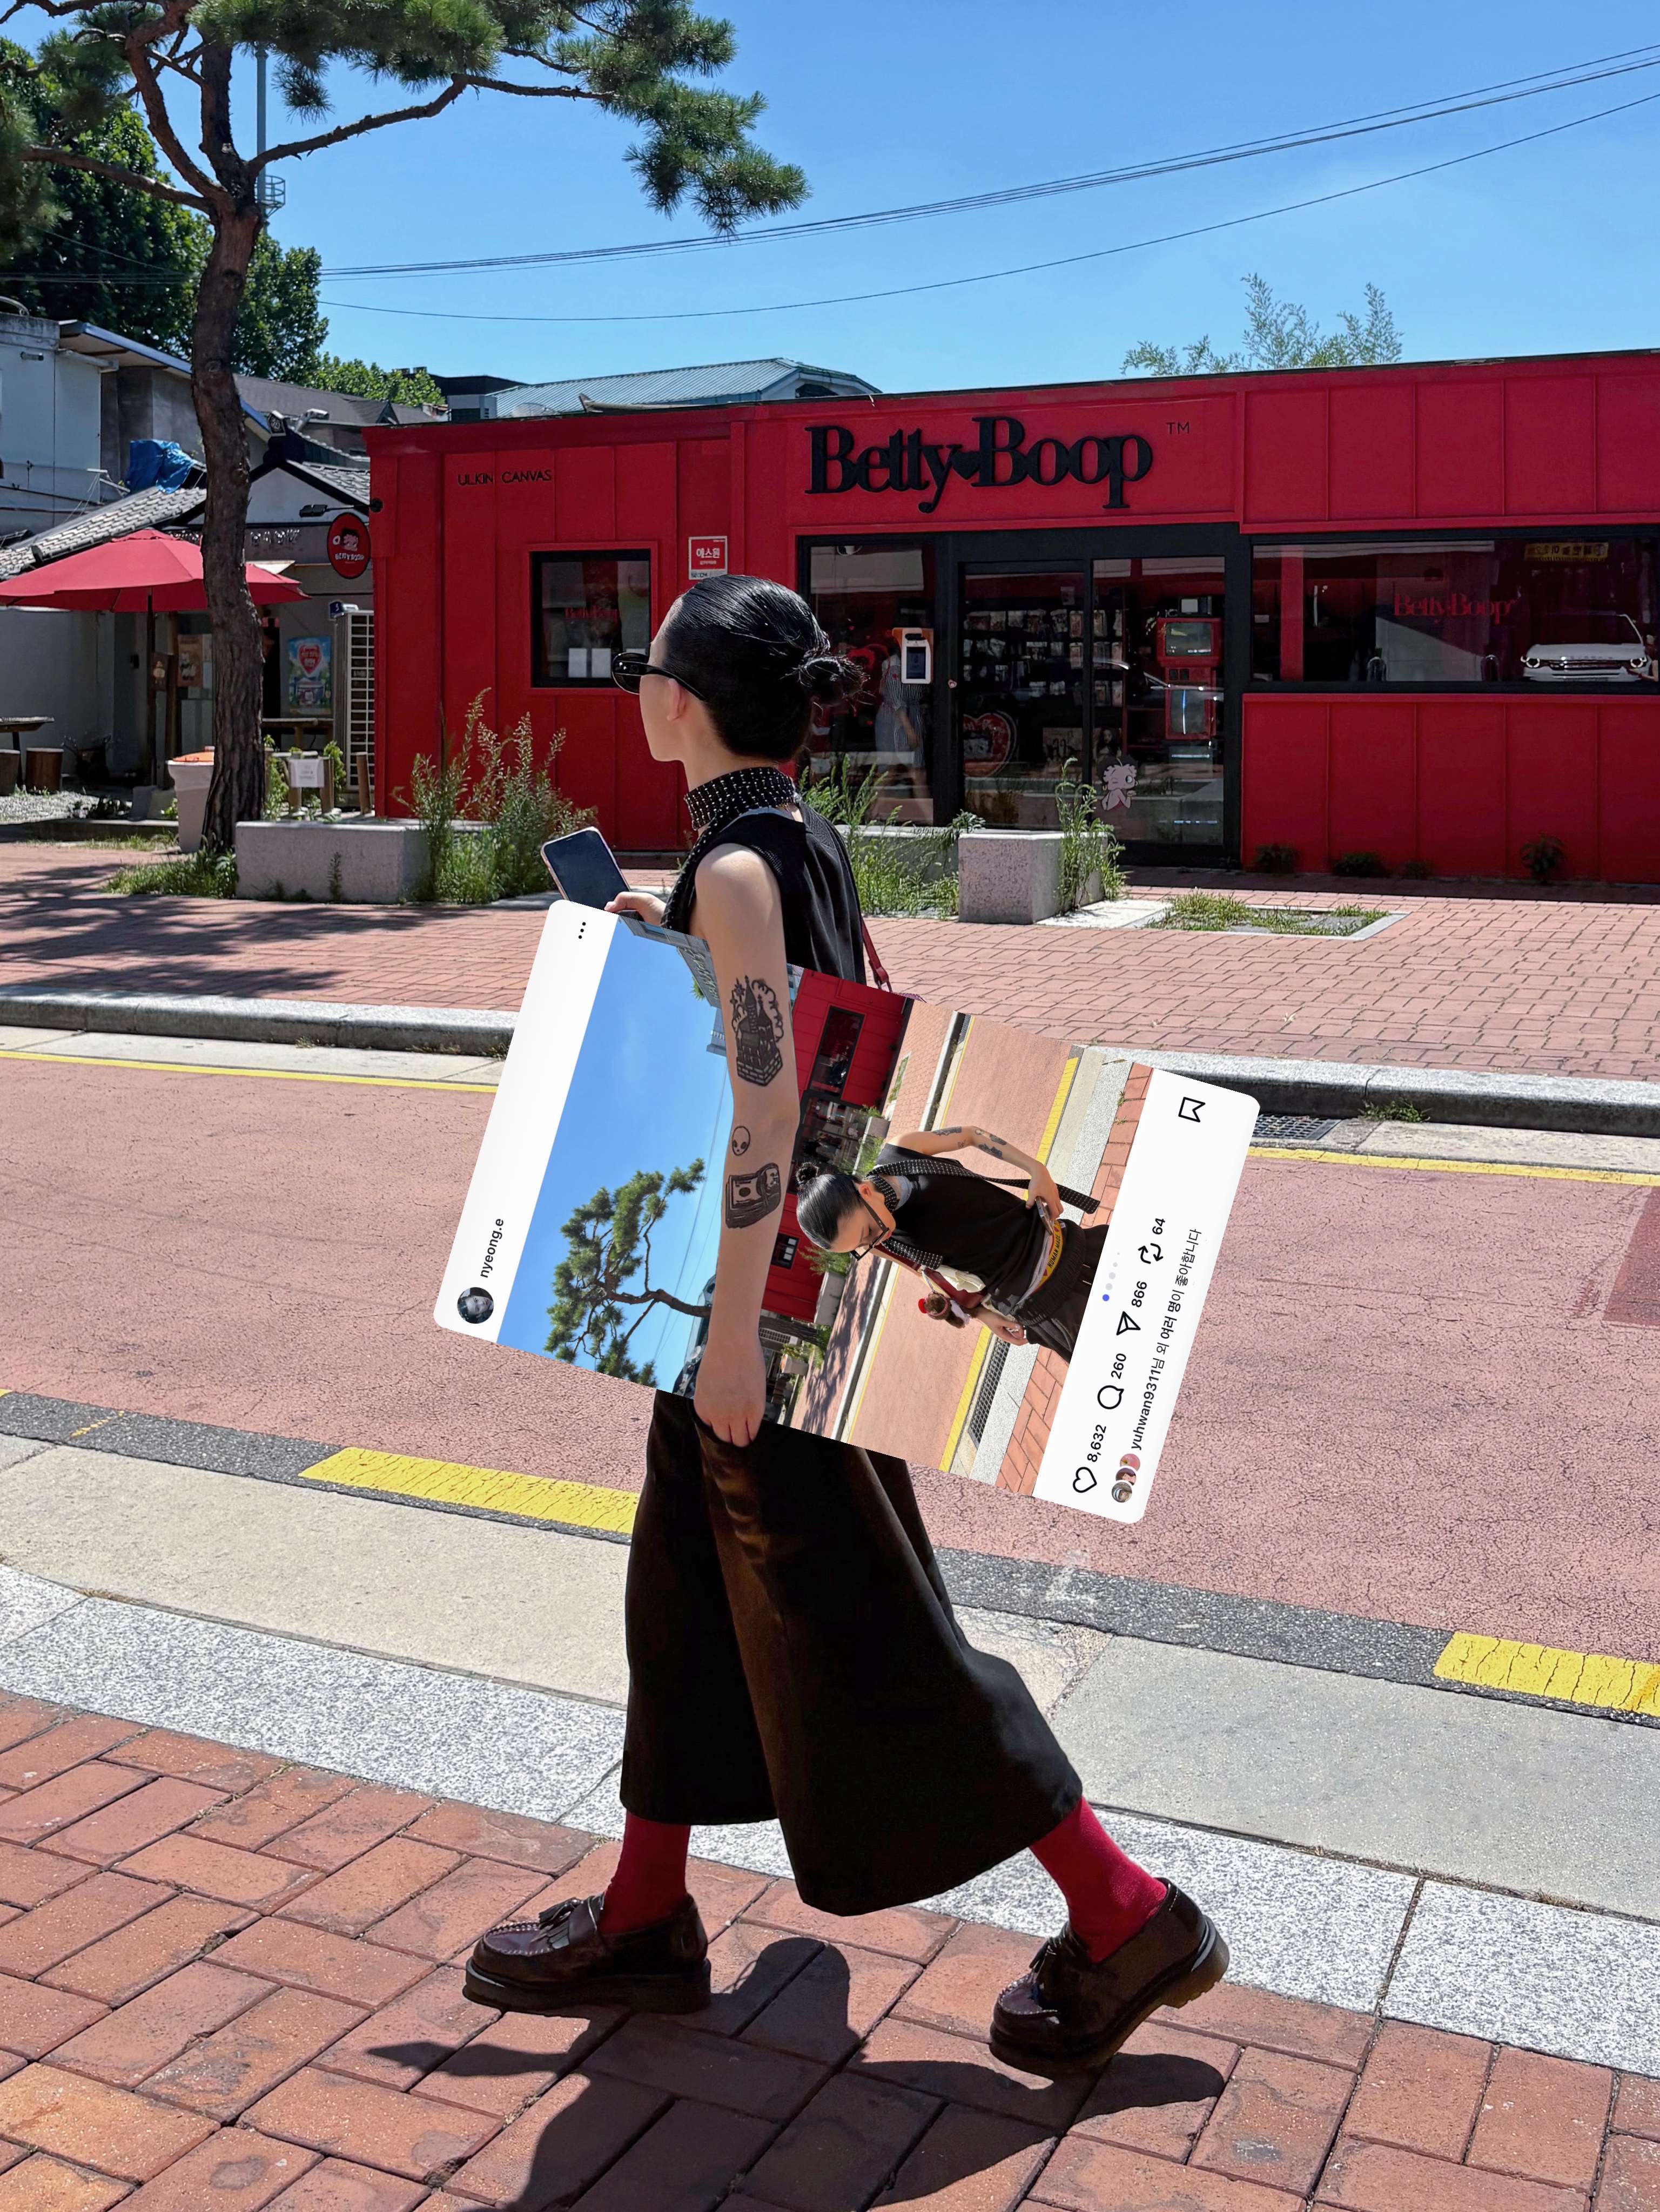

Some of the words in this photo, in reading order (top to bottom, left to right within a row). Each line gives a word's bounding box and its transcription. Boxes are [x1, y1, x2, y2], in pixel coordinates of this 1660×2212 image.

[458, 473, 493, 486] ULKIN
[501, 469, 552, 483] CANVAS
[805, 426, 963, 514] Betty
[972, 416, 1153, 509] Boop
[1450, 592, 1512, 625] Boop
[1047, 1249, 1059, 1268] HUMAN
